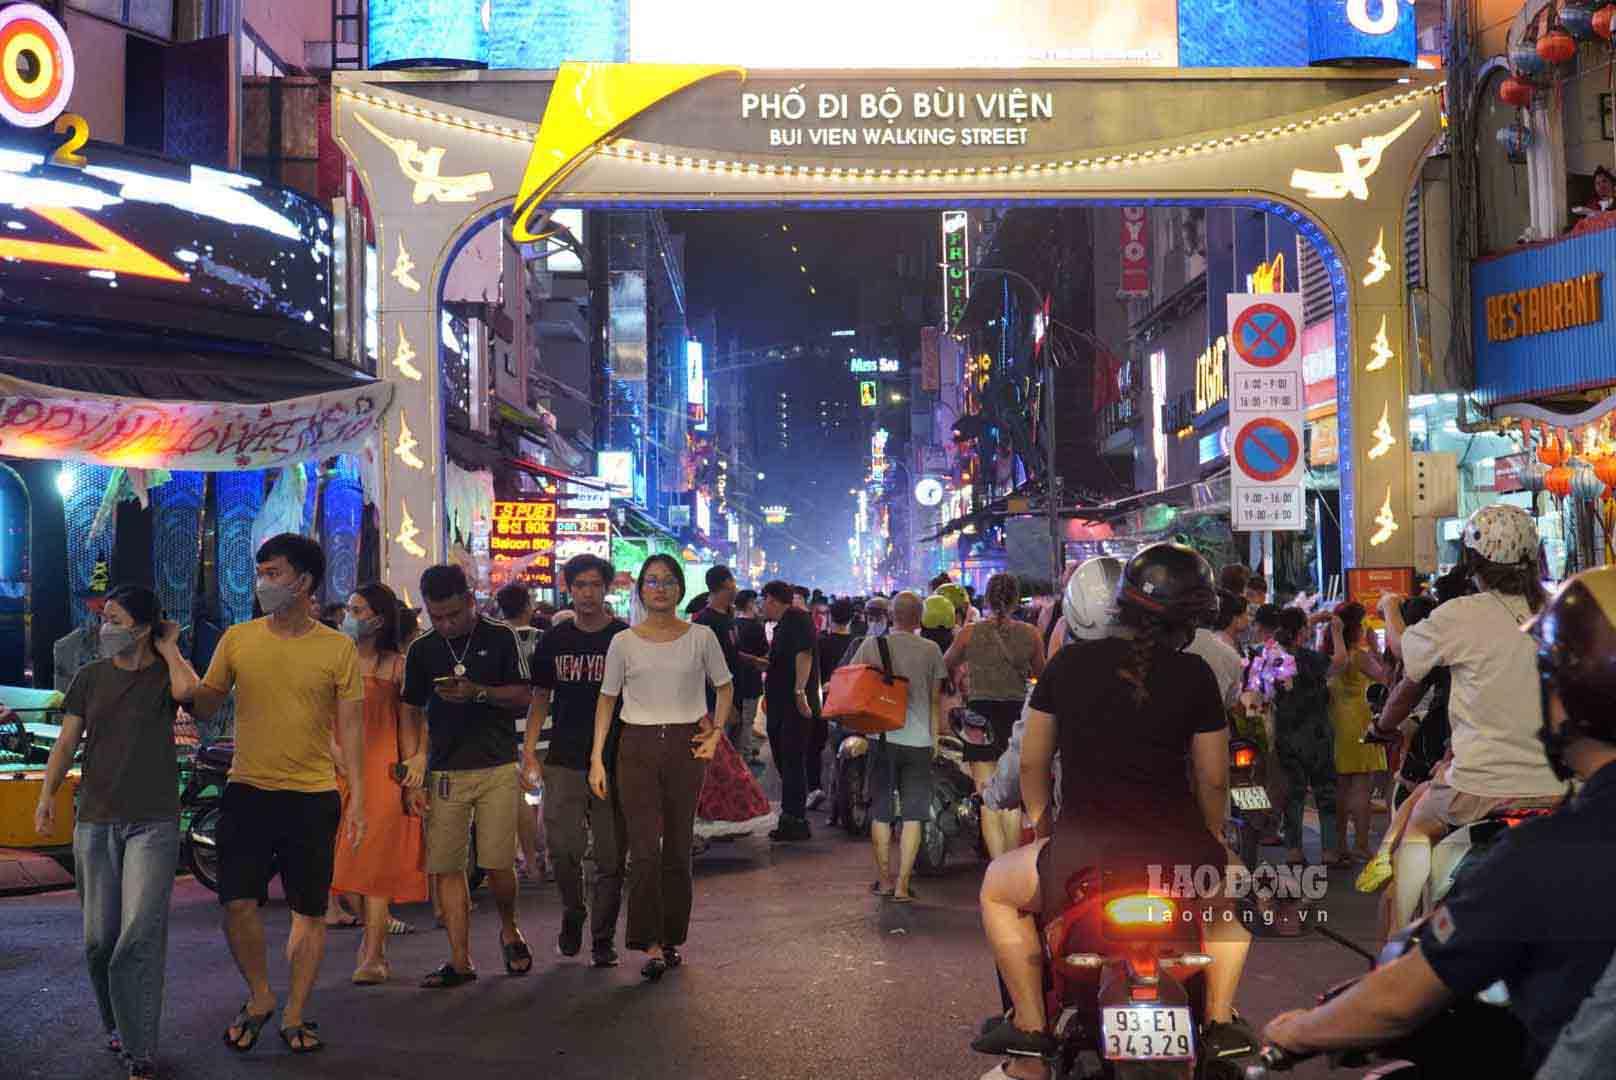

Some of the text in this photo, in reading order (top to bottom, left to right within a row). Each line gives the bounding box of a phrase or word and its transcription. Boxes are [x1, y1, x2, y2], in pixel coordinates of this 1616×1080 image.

[741, 83, 1054, 125] PHỐ ĐI BỘ BÙI VIỆN
[769, 127, 1028, 145] BUI VIEN WALKING STREET
[1485, 271, 1604, 344] RESTAURANT
[554, 654, 584, 681] NEW
[1116, 1010, 1177, 1033] 93-E1
[1108, 1034, 1190, 1057] 343.29
